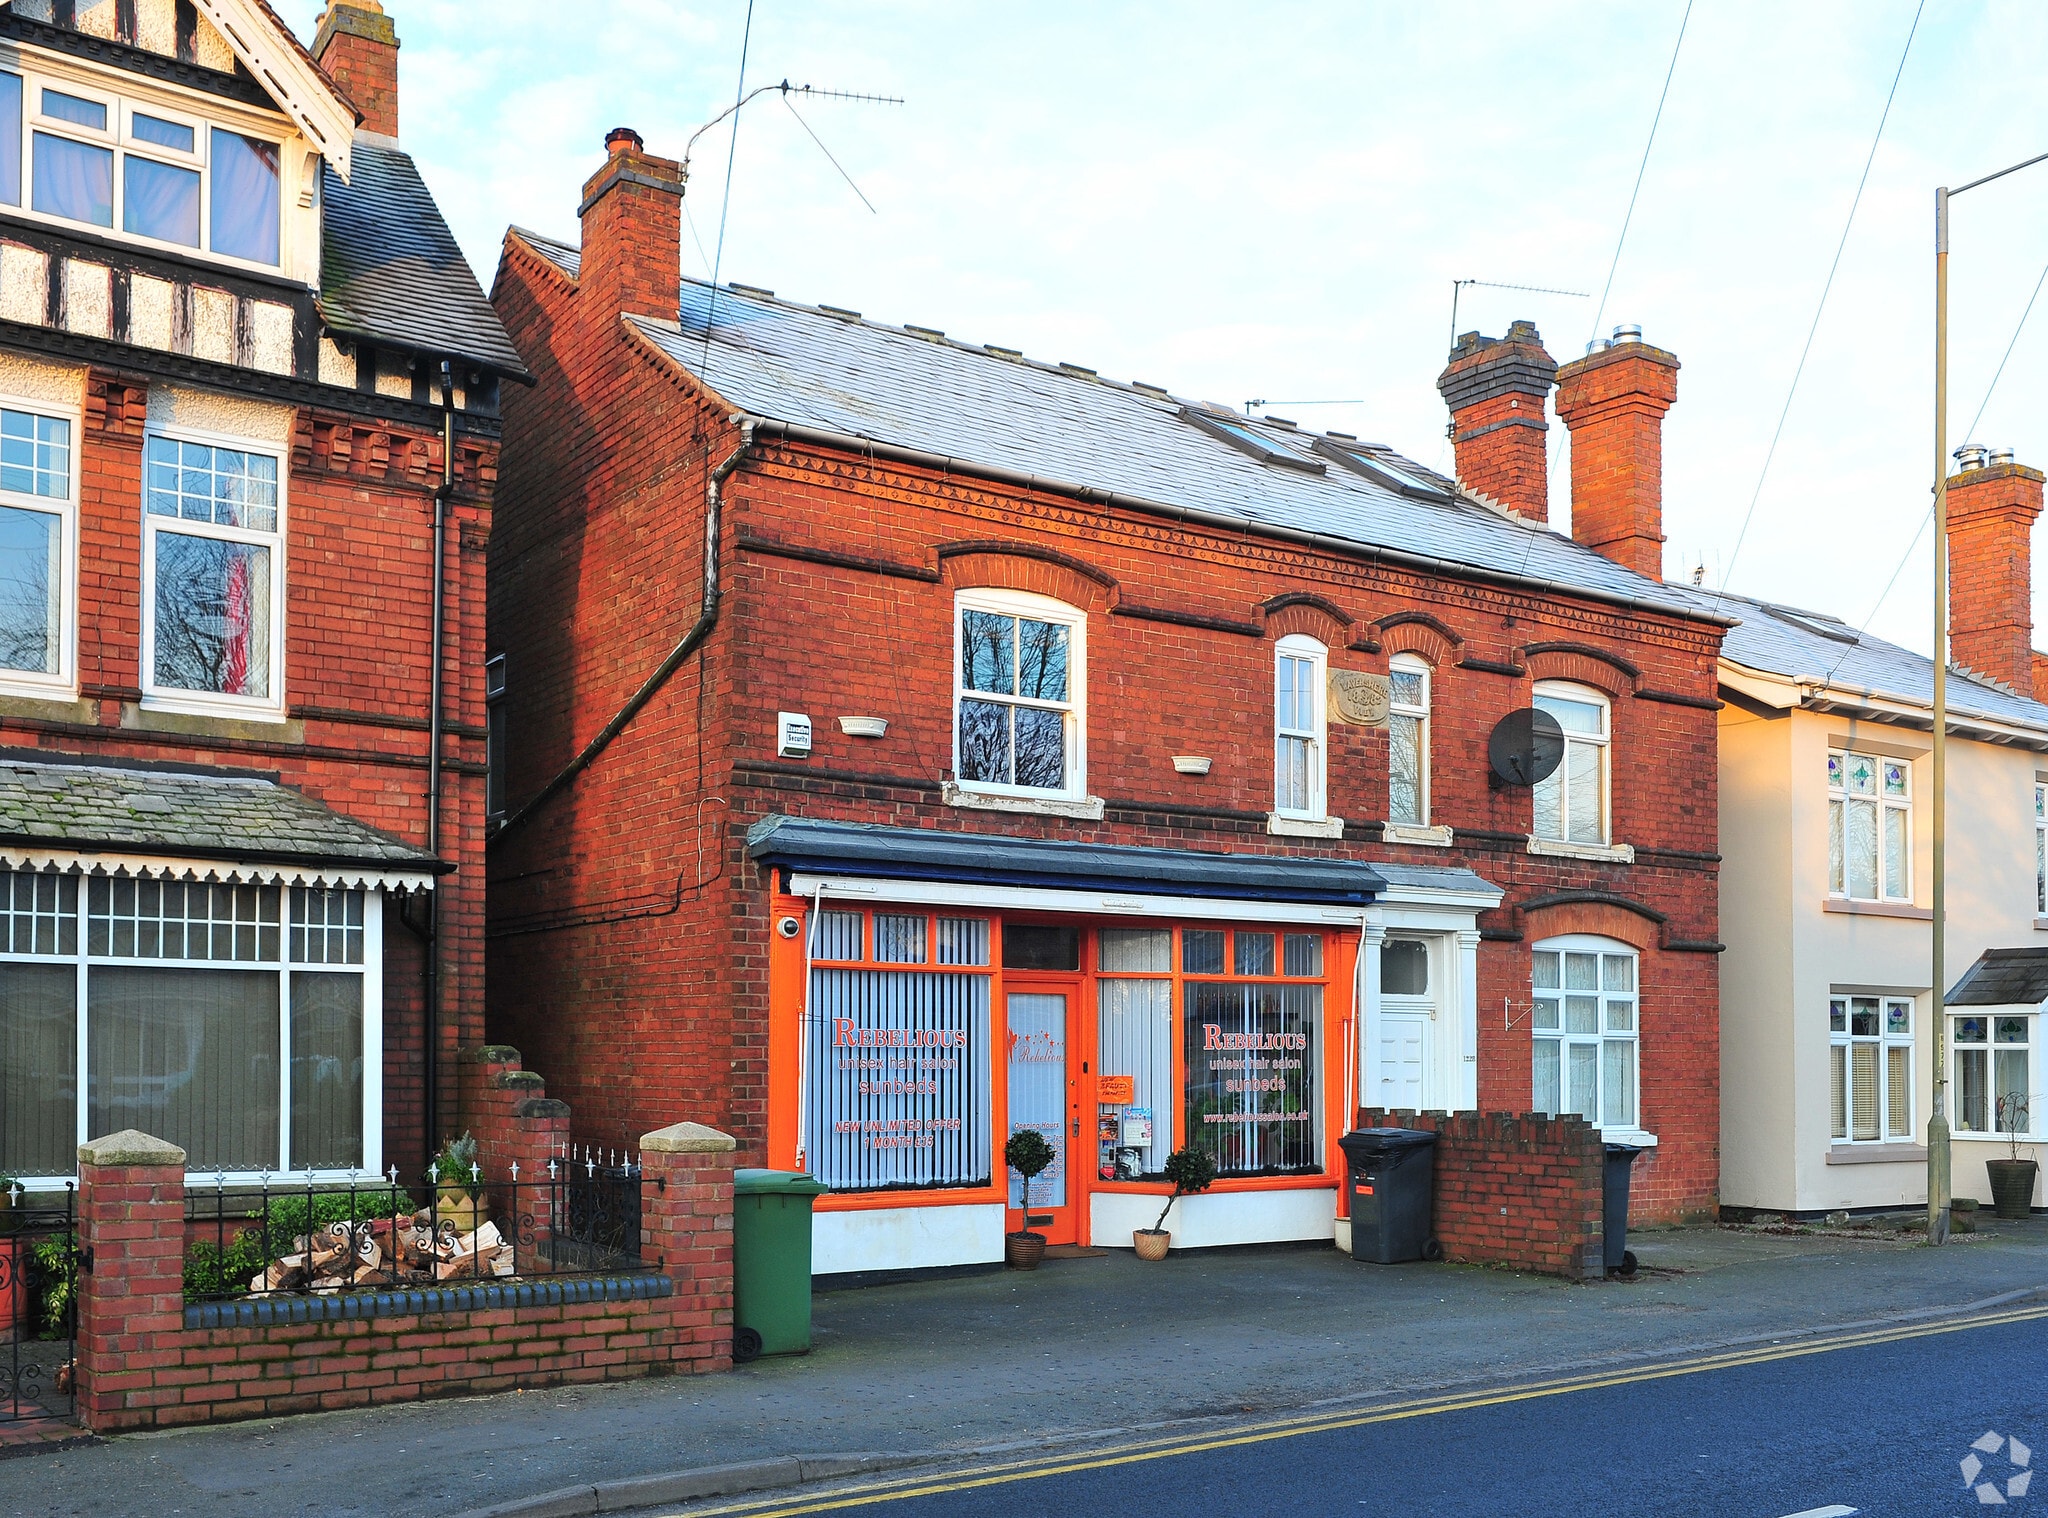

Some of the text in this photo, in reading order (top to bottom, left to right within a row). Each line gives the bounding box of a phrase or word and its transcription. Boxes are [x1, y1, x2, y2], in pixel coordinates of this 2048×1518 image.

[833, 1018, 966, 1047] REBELIOUS
[1203, 1024, 1306, 1050] REBELIOUS
[838, 1056, 957, 1069] unisex hair salon
[1209, 1057, 1301, 1070] unisex hair salon
[859, 1076, 937, 1095] sunbeds
[1226, 1075, 1286, 1092] sunbeds
[834, 1118, 961, 1133] NEW UNLIMITED OFFER
[1014, 1121, 1060, 1130] Opening Hours
[864, 1135, 934, 1149] 1 MONTH £35
